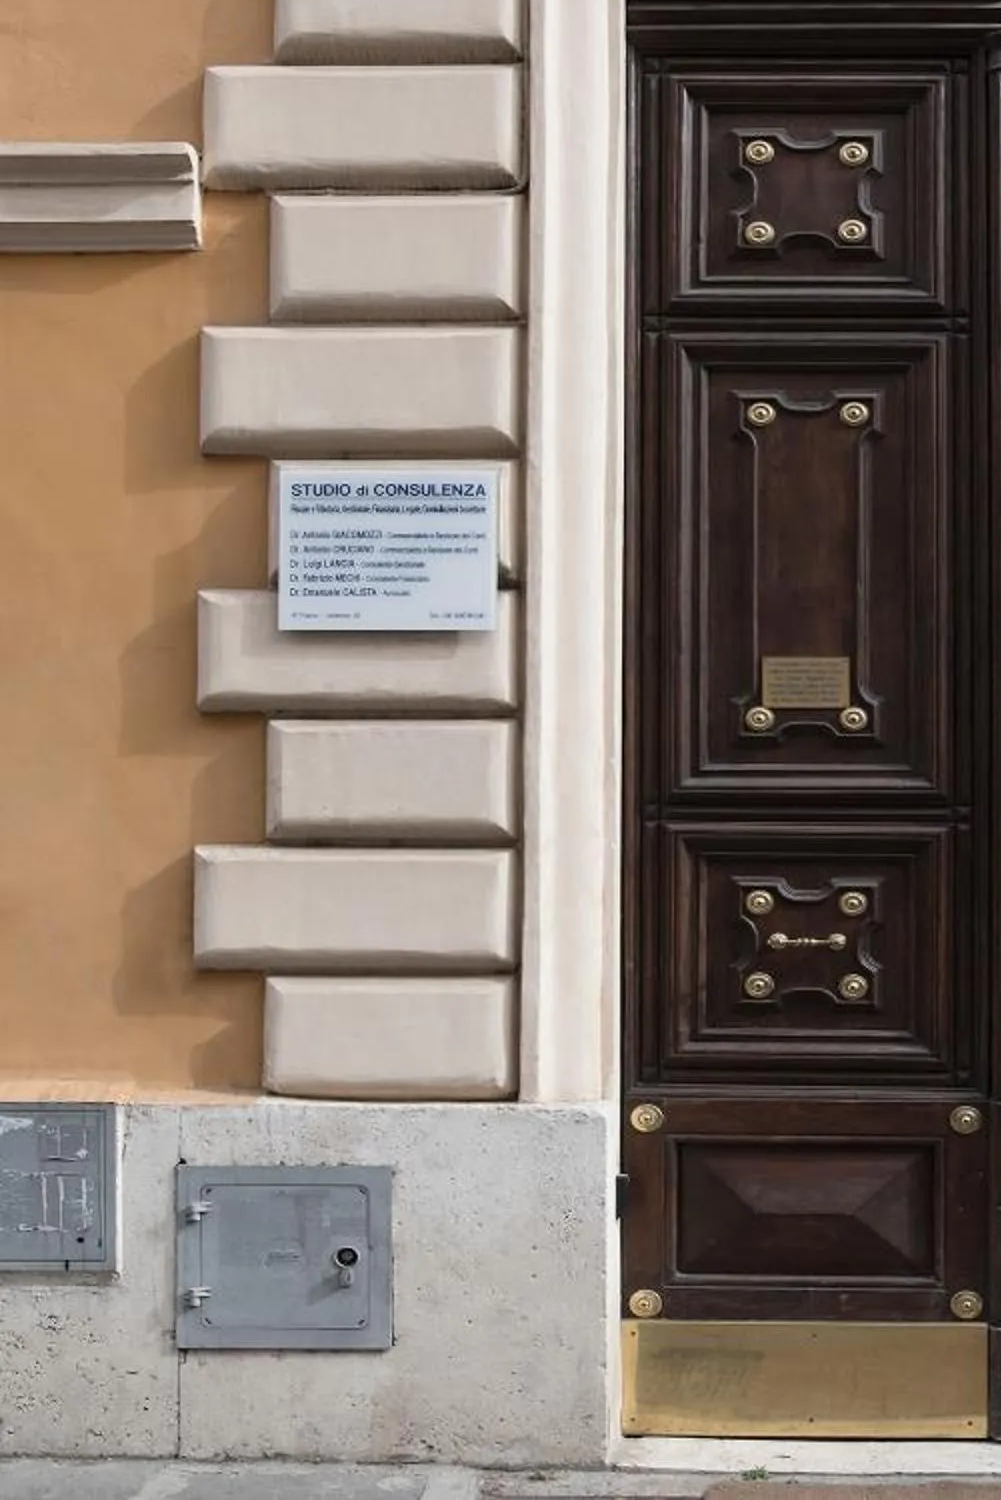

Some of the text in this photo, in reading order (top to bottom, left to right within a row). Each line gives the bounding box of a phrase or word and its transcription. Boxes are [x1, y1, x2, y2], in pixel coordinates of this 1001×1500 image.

[291, 483, 487, 497] STUDIO di CONSULENZA
